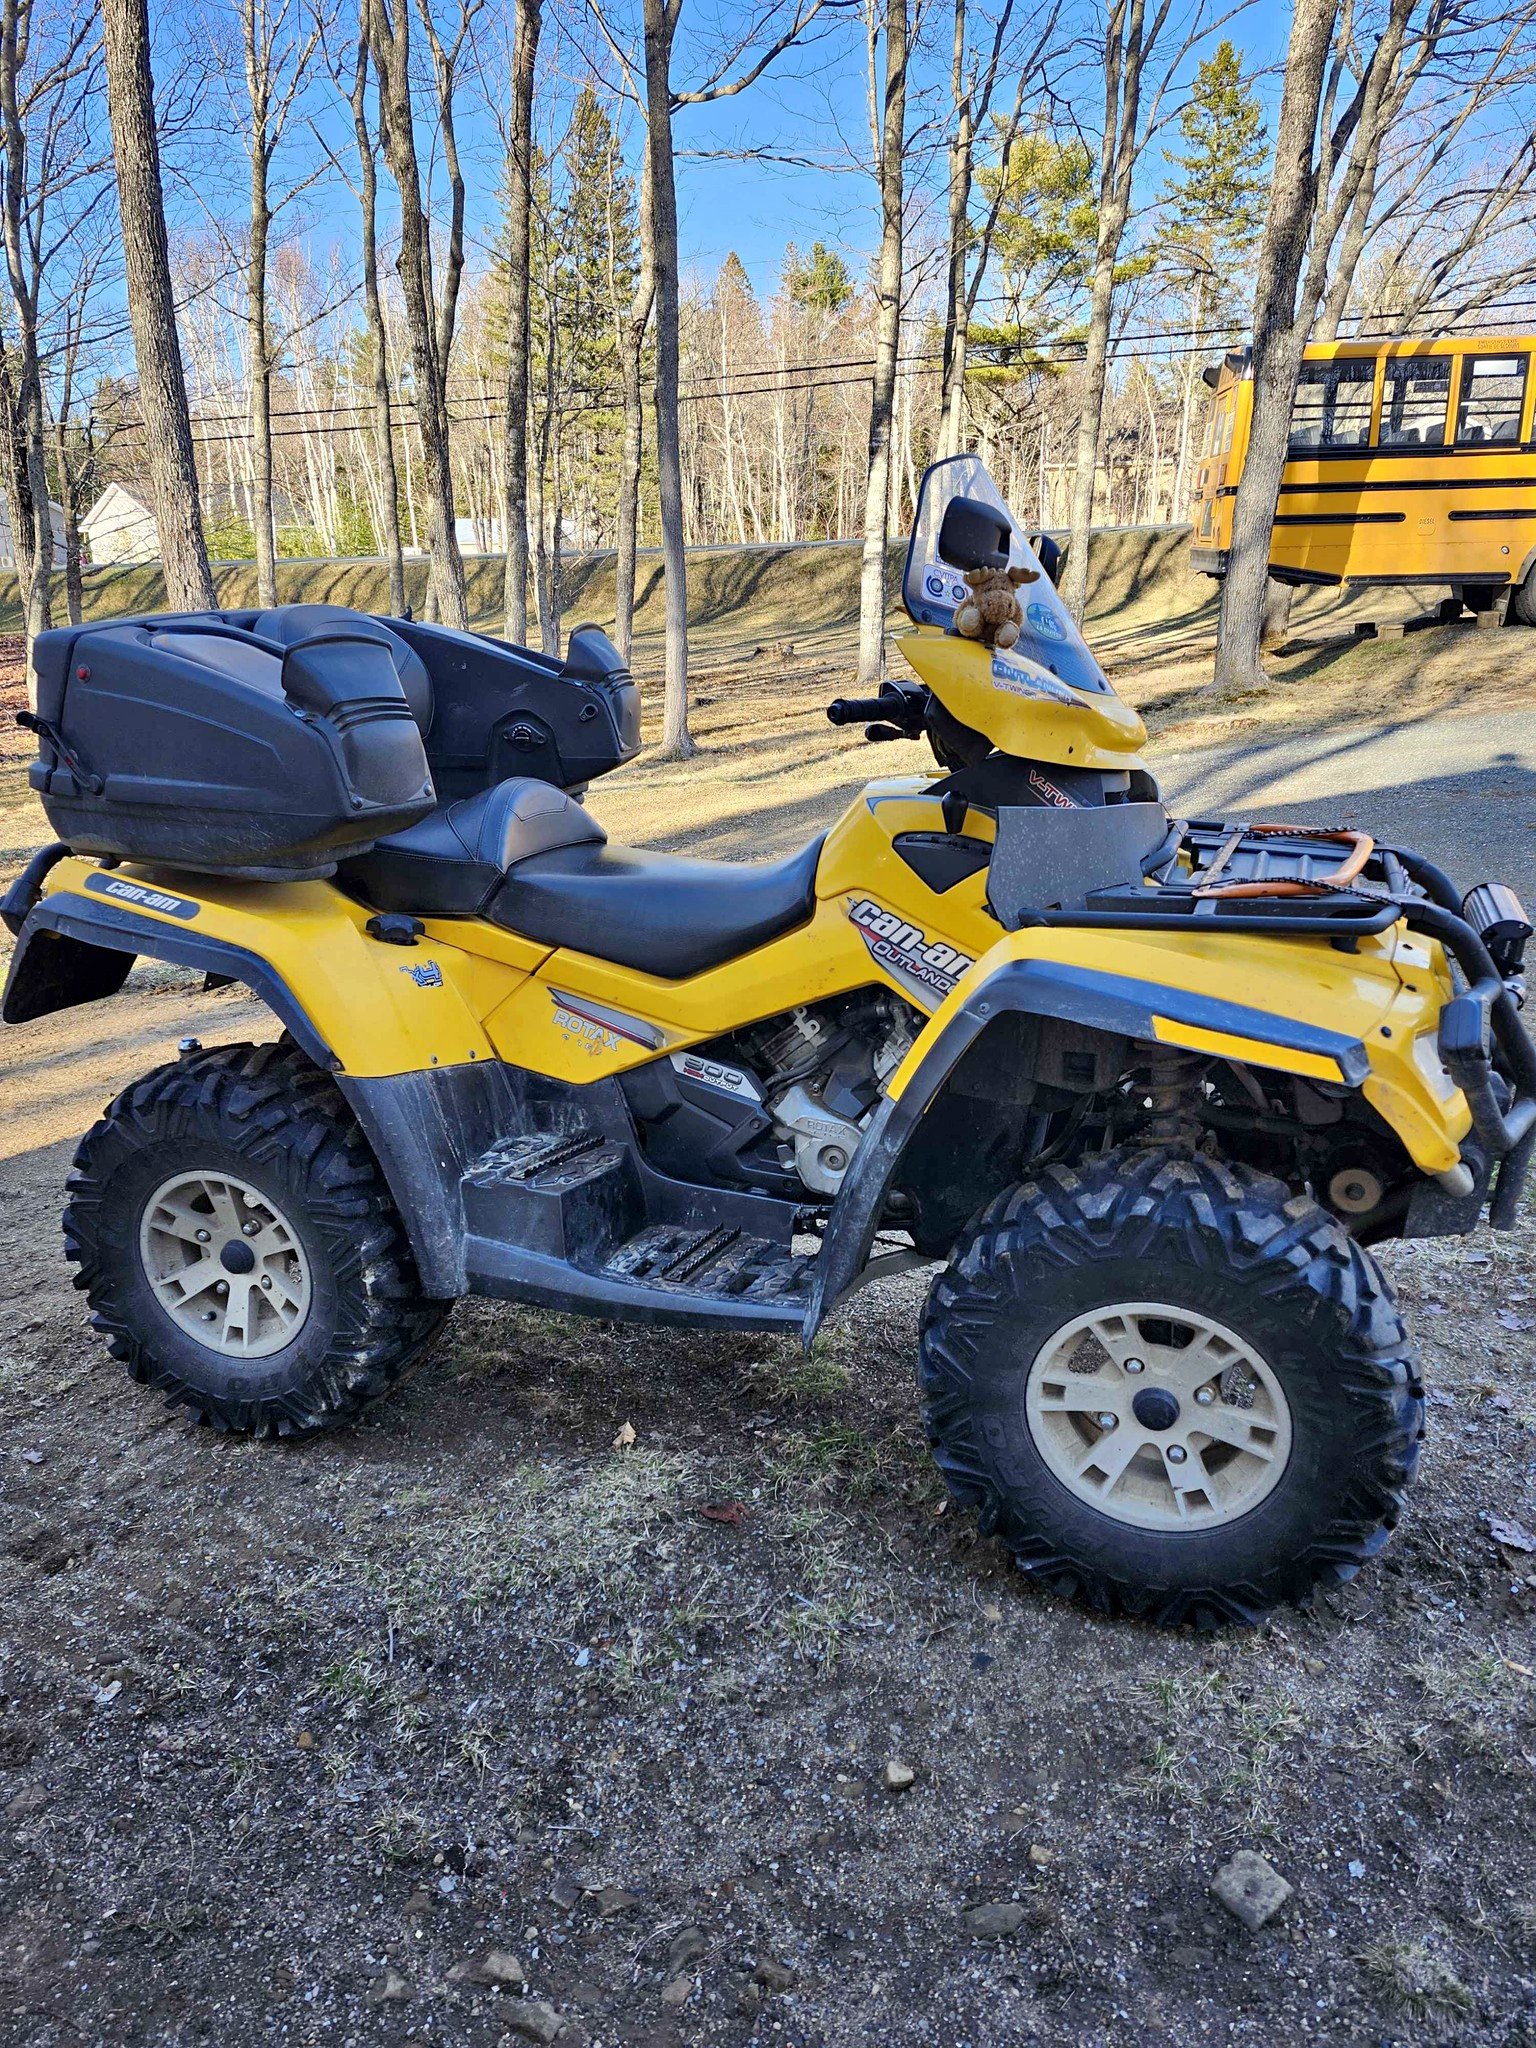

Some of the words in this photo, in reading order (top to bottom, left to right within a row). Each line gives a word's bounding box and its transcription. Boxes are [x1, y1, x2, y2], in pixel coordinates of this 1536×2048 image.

[1029, 769, 1078, 809] V-TW
[105, 881, 181, 911] can-am
[552, 1008, 621, 1052] ROTAX
[684, 1056, 743, 1085] 800
[703, 1075, 739, 1091] OUTPUT
[807, 1119, 848, 1136] ROTAX
